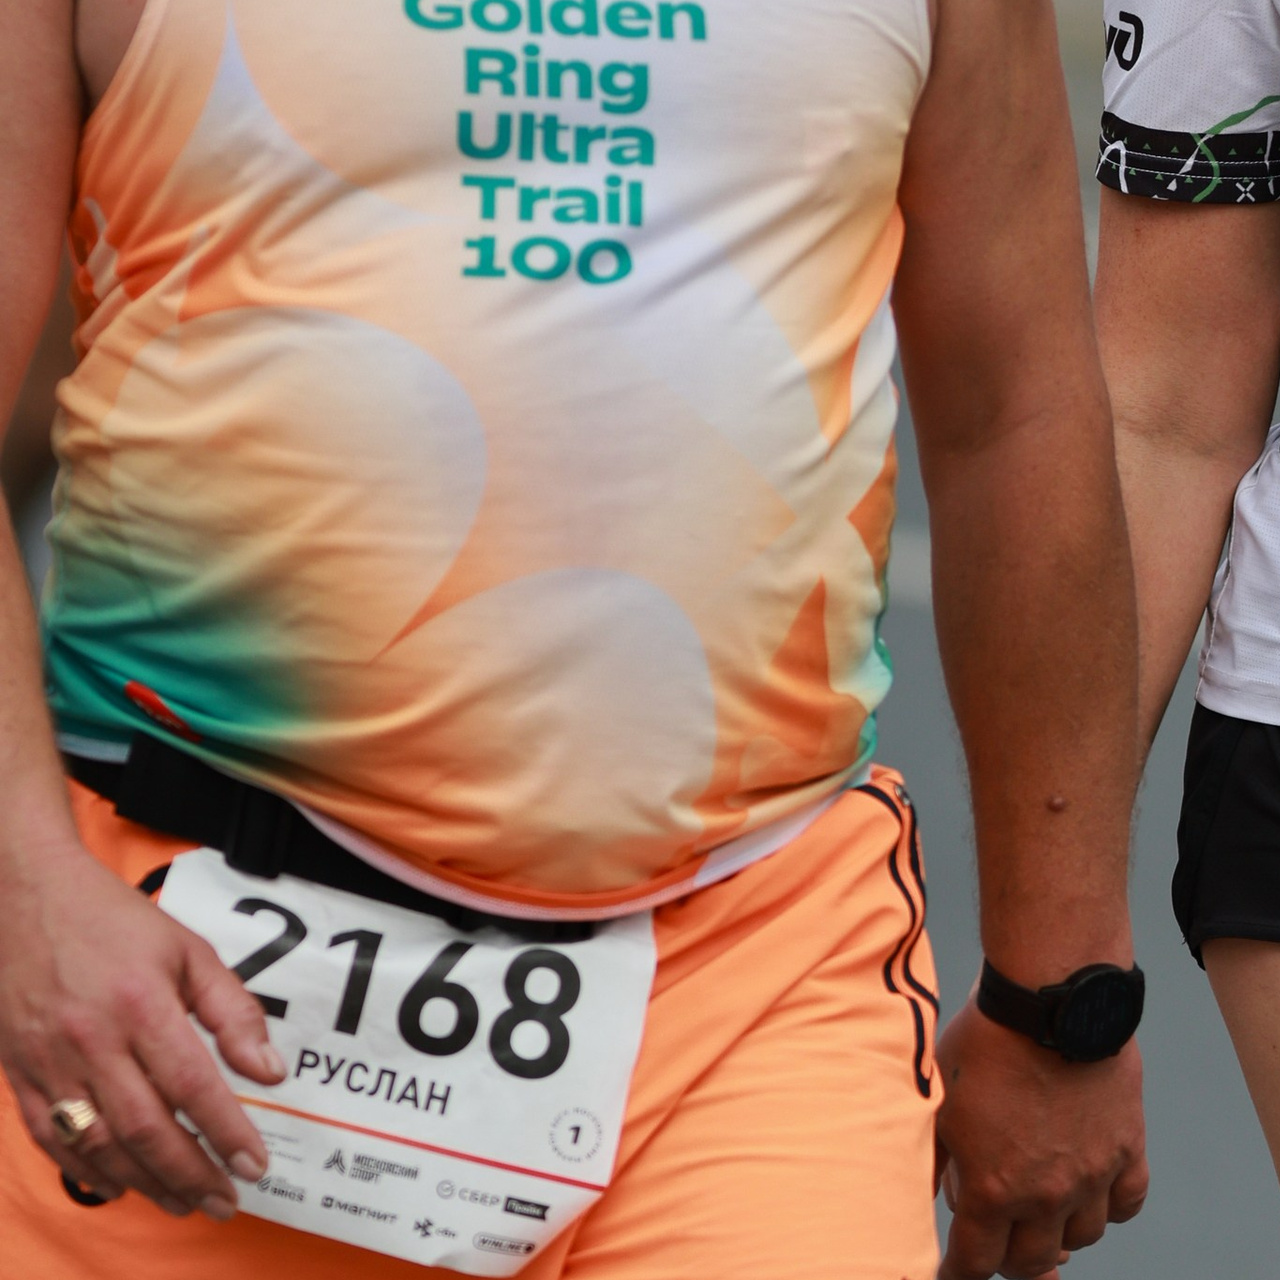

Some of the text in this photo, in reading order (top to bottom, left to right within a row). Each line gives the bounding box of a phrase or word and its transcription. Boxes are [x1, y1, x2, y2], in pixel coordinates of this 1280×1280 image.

[464, 43, 649, 114] Ring
[457, 110, 655, 166] Ultra
[462, 175, 643, 227] Trail
[462, 235, 632, 285] 100
[230, 897, 581, 1079] 2168
[295, 1049, 452, 1115] РУСЛАН
